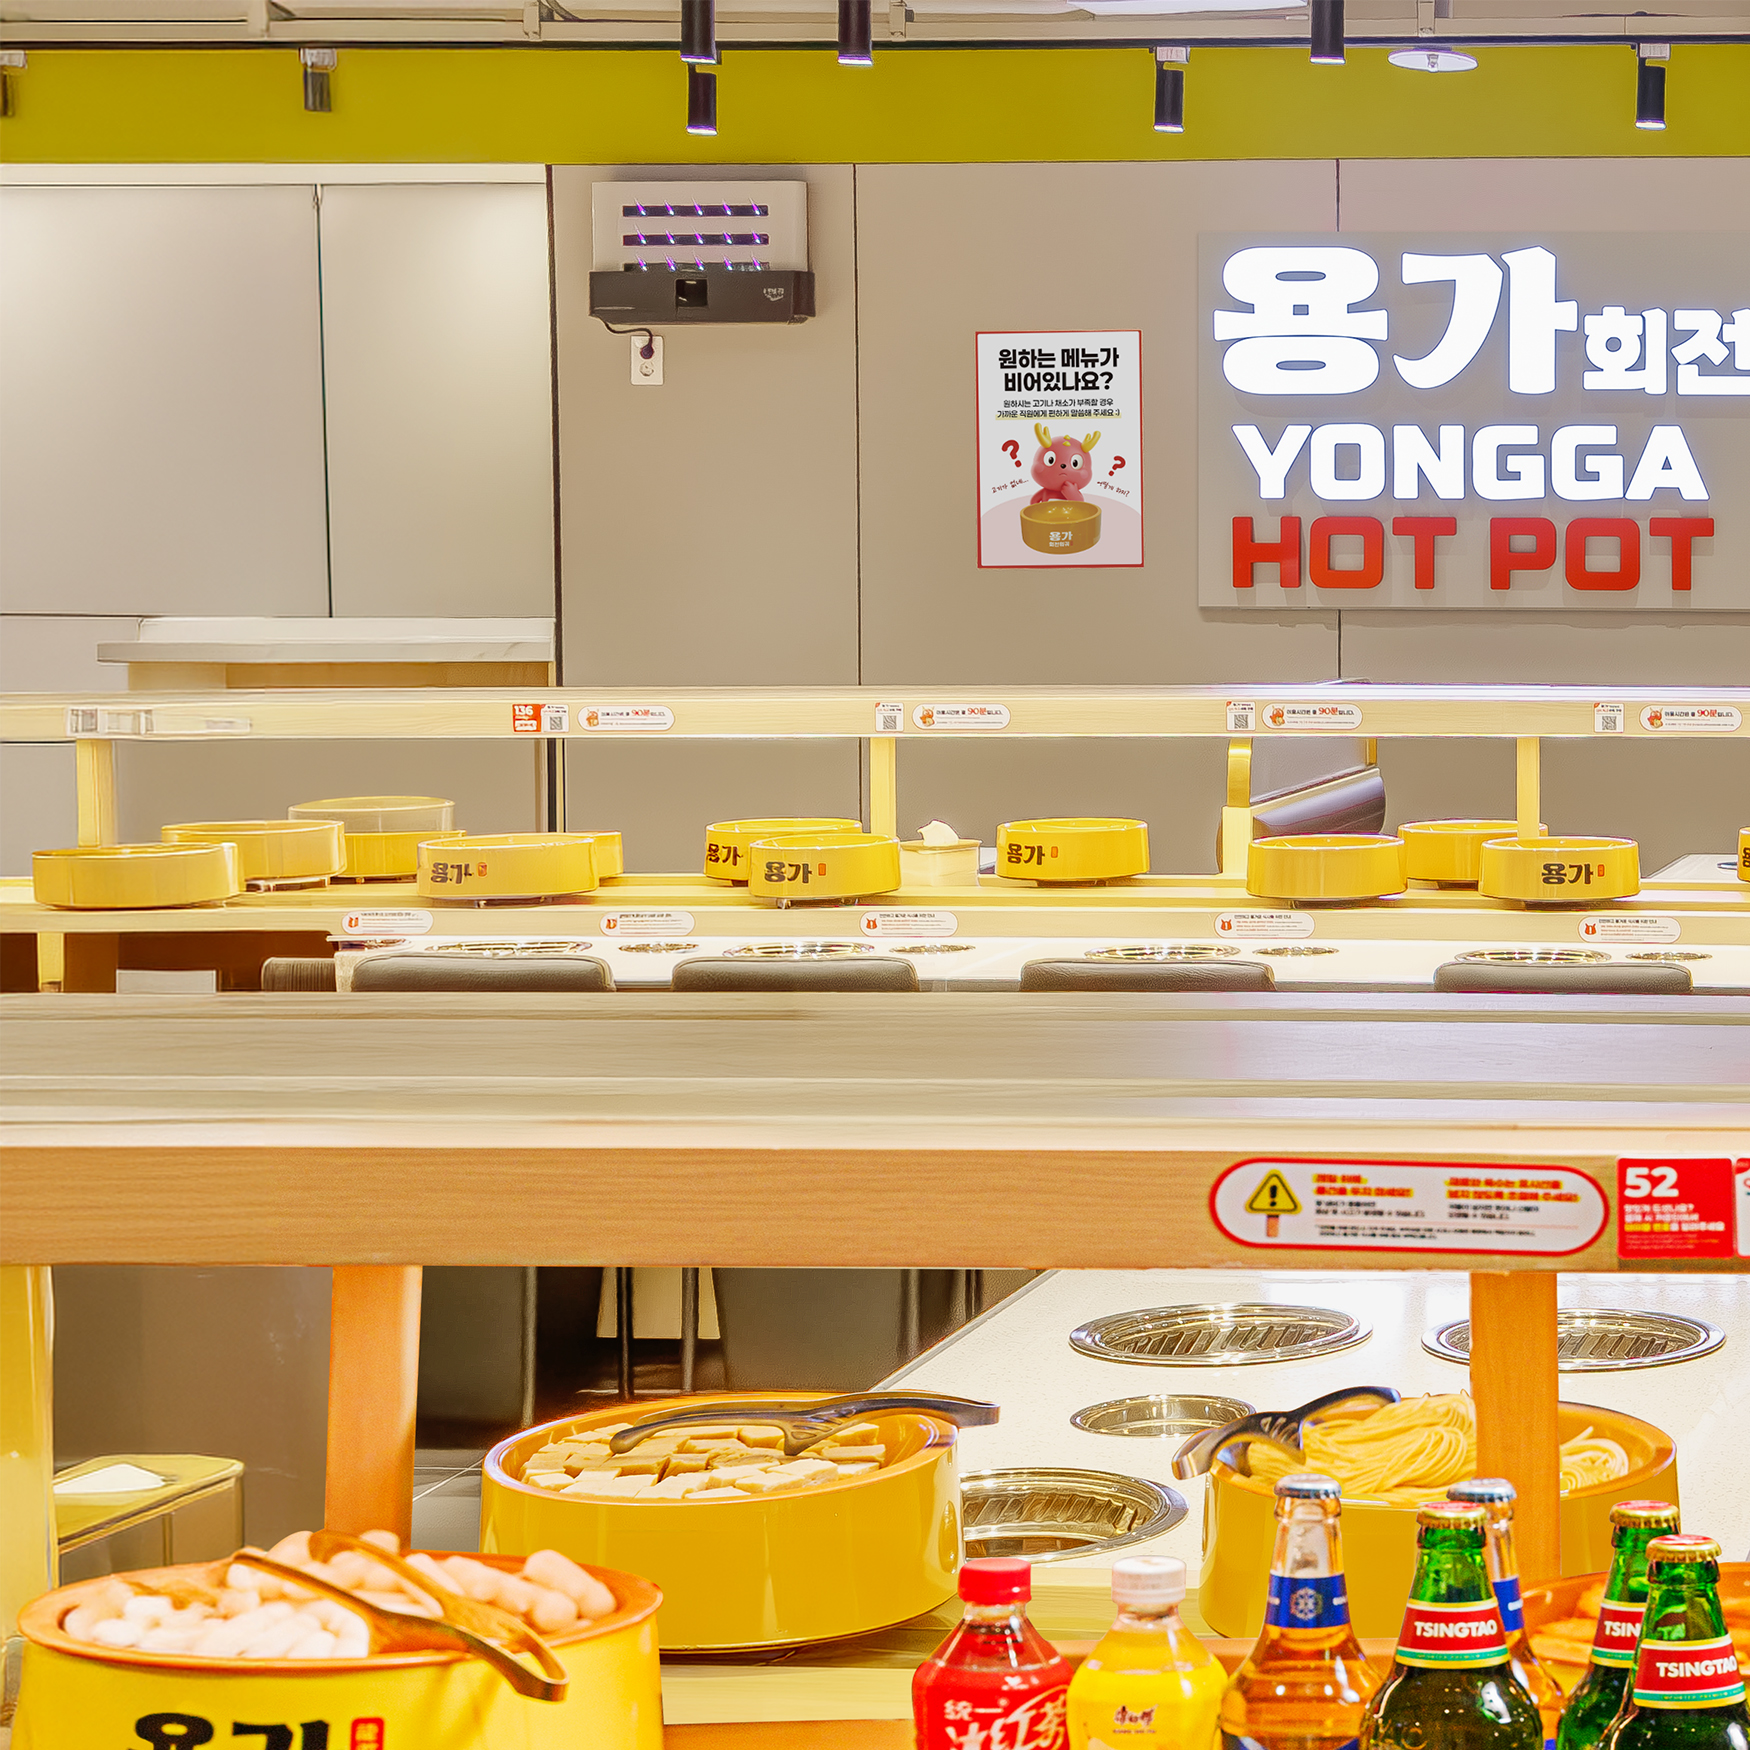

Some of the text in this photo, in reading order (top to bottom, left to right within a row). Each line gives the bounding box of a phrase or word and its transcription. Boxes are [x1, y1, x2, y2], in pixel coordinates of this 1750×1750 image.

[1213, 245, 1579, 396] 용가
[998, 347, 1119, 369] 원하는 메뉴가
[1004, 371, 1114, 392] 비어있나요?
[997, 410, 1018, 418] 가까운
[1020, 409, 1047, 418] 직원에게
[1048, 409, 1070, 418] 편하게
[1070, 409, 1092, 417] 말씀해
[1093, 409, 1114, 417] 주세요
[1003, 398, 1114, 408] 원하시는 고기나 채소가 부족할 경우
[1001, 439, 1022, 468] ?
[1231, 422, 1711, 500] YONGGA
[1108, 455, 1126, 477] ?
[1049, 531, 1073, 541] 용가
[1231, 516, 1715, 591] HOT POT
[1006, 842, 1045, 866] 용가
[764, 861, 812, 883] 용가
[1541, 862, 1594, 886] 용가
[1624, 1166, 1679, 1198] 52
[1414, 1619, 1498, 1638] TSINGTAO
[1604, 1620, 1640, 1637] TSIN
[1656, 1655, 1738, 1678] TSINGTAO
